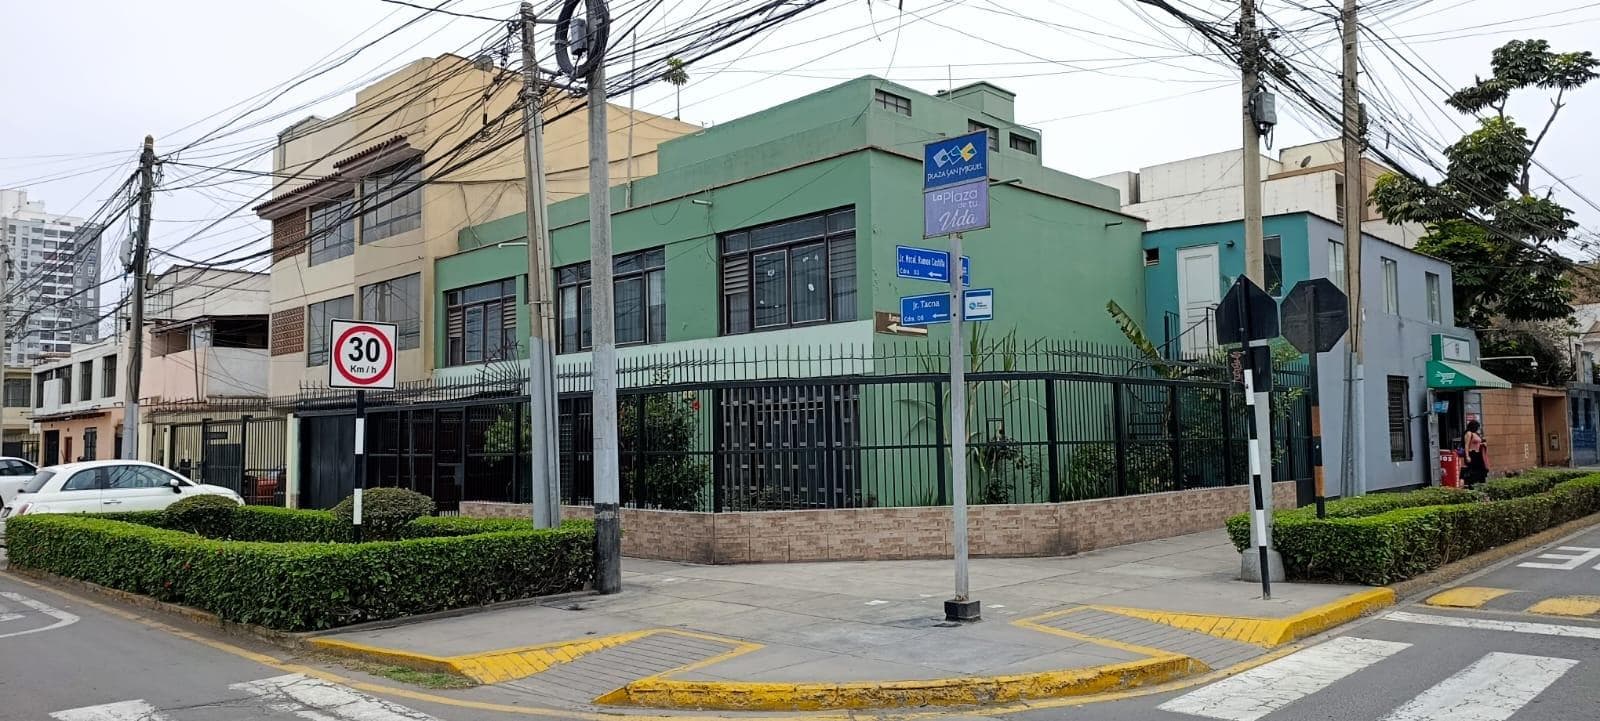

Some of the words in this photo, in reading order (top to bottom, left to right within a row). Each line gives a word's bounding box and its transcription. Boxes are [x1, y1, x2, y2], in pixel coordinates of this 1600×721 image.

[928, 171, 946, 182] PLAZA
[946, 167, 958, 177] SAN
[959, 163, 983, 175] MIGUEL
[932, 193, 943, 201] La
[944, 190, 978, 204] Plaza
[969, 200, 978, 208] tu
[939, 209, 977, 231] Vida
[920, 300, 940, 308] Tacna
[348, 336, 380, 363] 30
